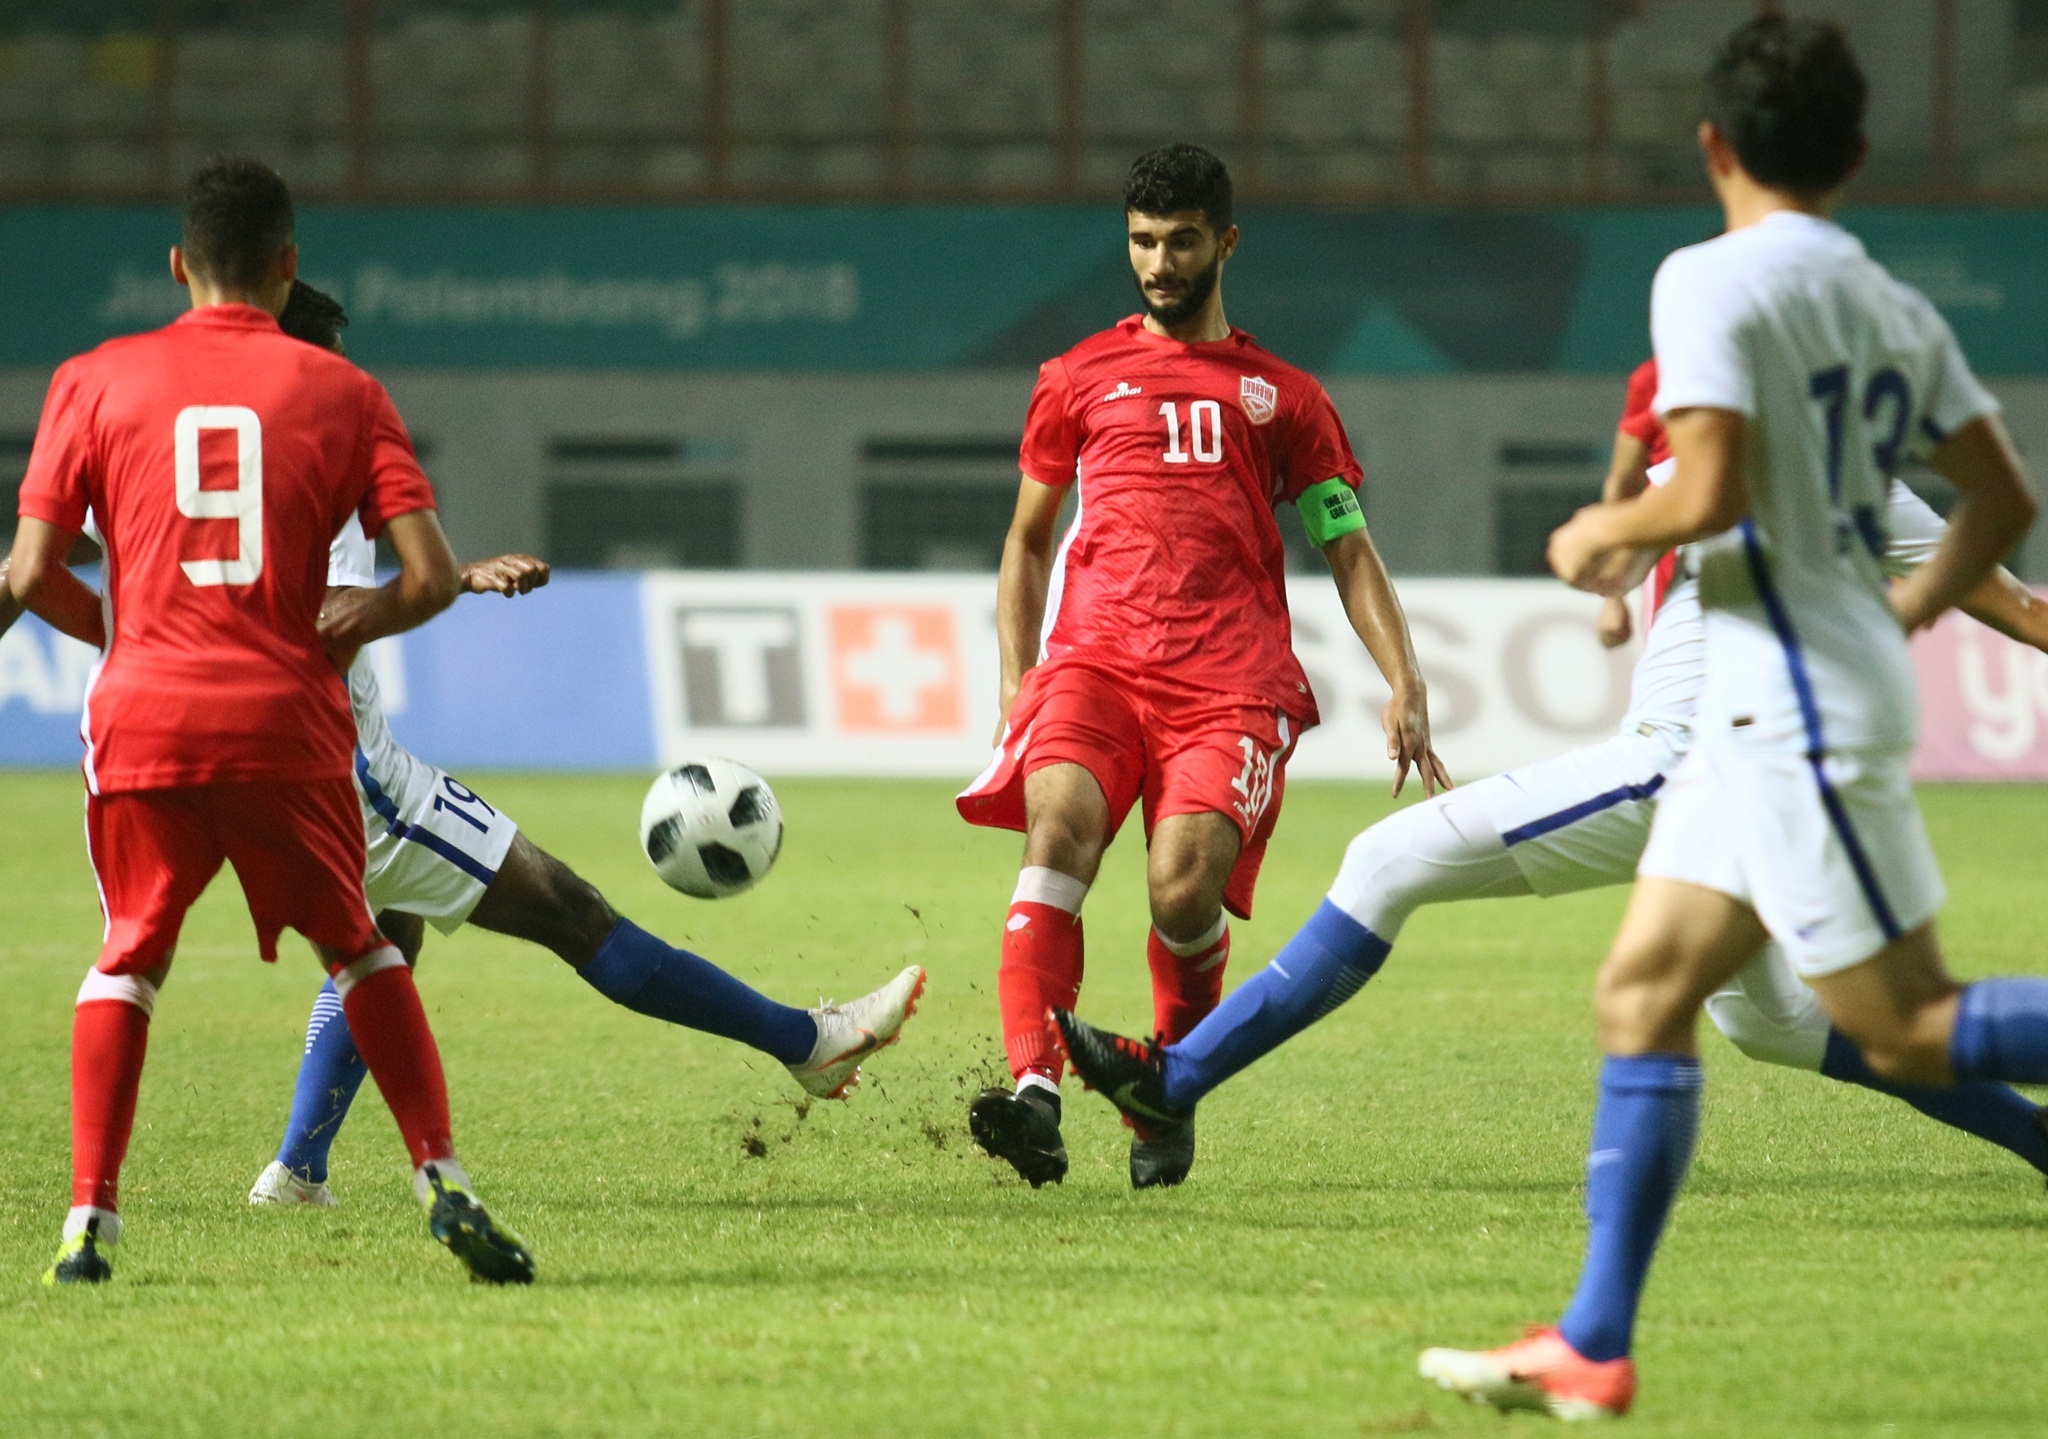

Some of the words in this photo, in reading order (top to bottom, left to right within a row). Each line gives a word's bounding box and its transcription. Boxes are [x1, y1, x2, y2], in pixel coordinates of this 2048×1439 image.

[1158, 400, 1222, 463] 10
[174, 405, 263, 587] 9
[433, 776, 495, 834] 19
